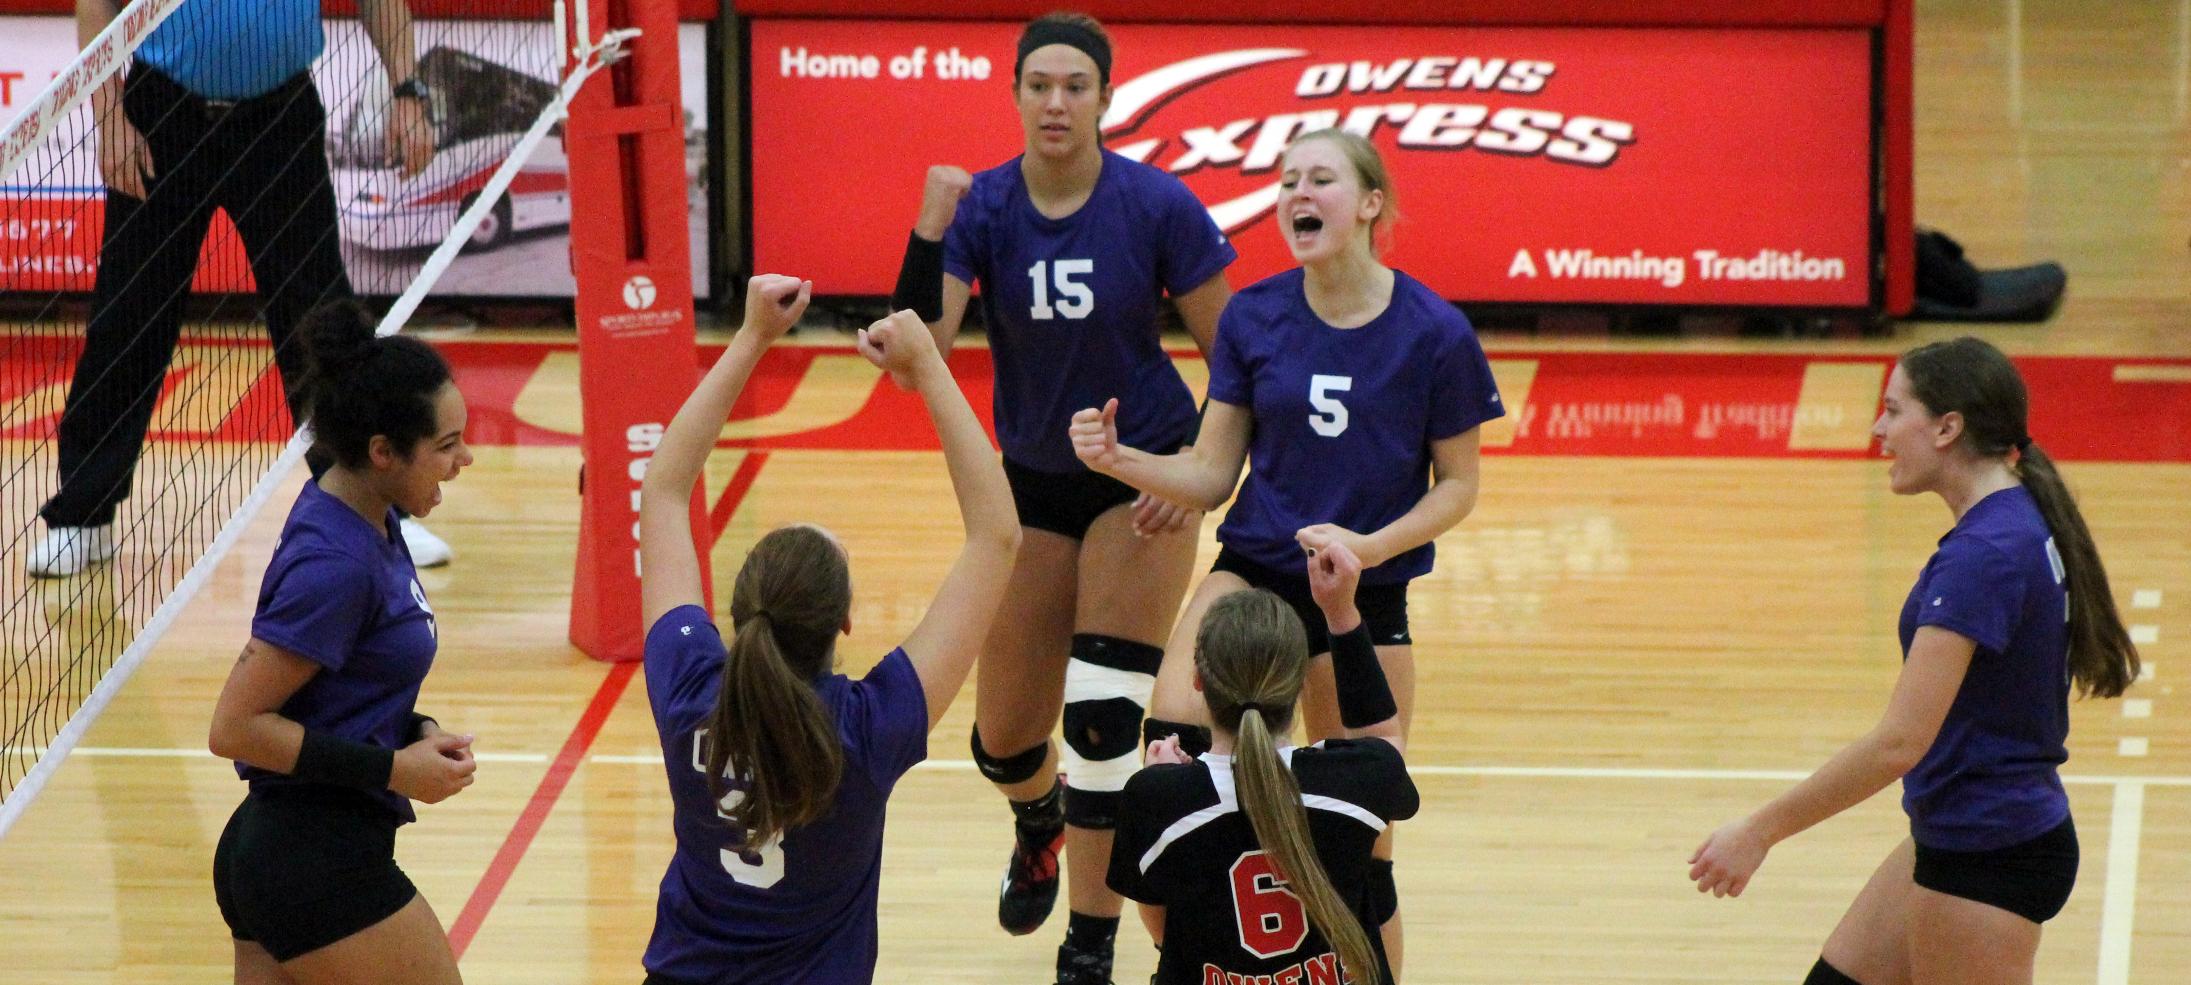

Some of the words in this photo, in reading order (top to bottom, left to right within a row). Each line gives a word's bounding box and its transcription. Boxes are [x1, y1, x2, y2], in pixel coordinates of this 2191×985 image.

[780, 46, 880, 79] Home
[889, 46, 928, 80] of
[933, 46, 992, 80] the
[1295, 56, 1556, 97] OWENS
[1028, 258, 1095, 320] 15
[1507, 249, 1538, 278] A
[1545, 248, 1685, 287] Winning
[1693, 249, 1846, 281] Tradition
[1308, 375, 1353, 438] 5
[1229, 849, 1310, 960] 6
